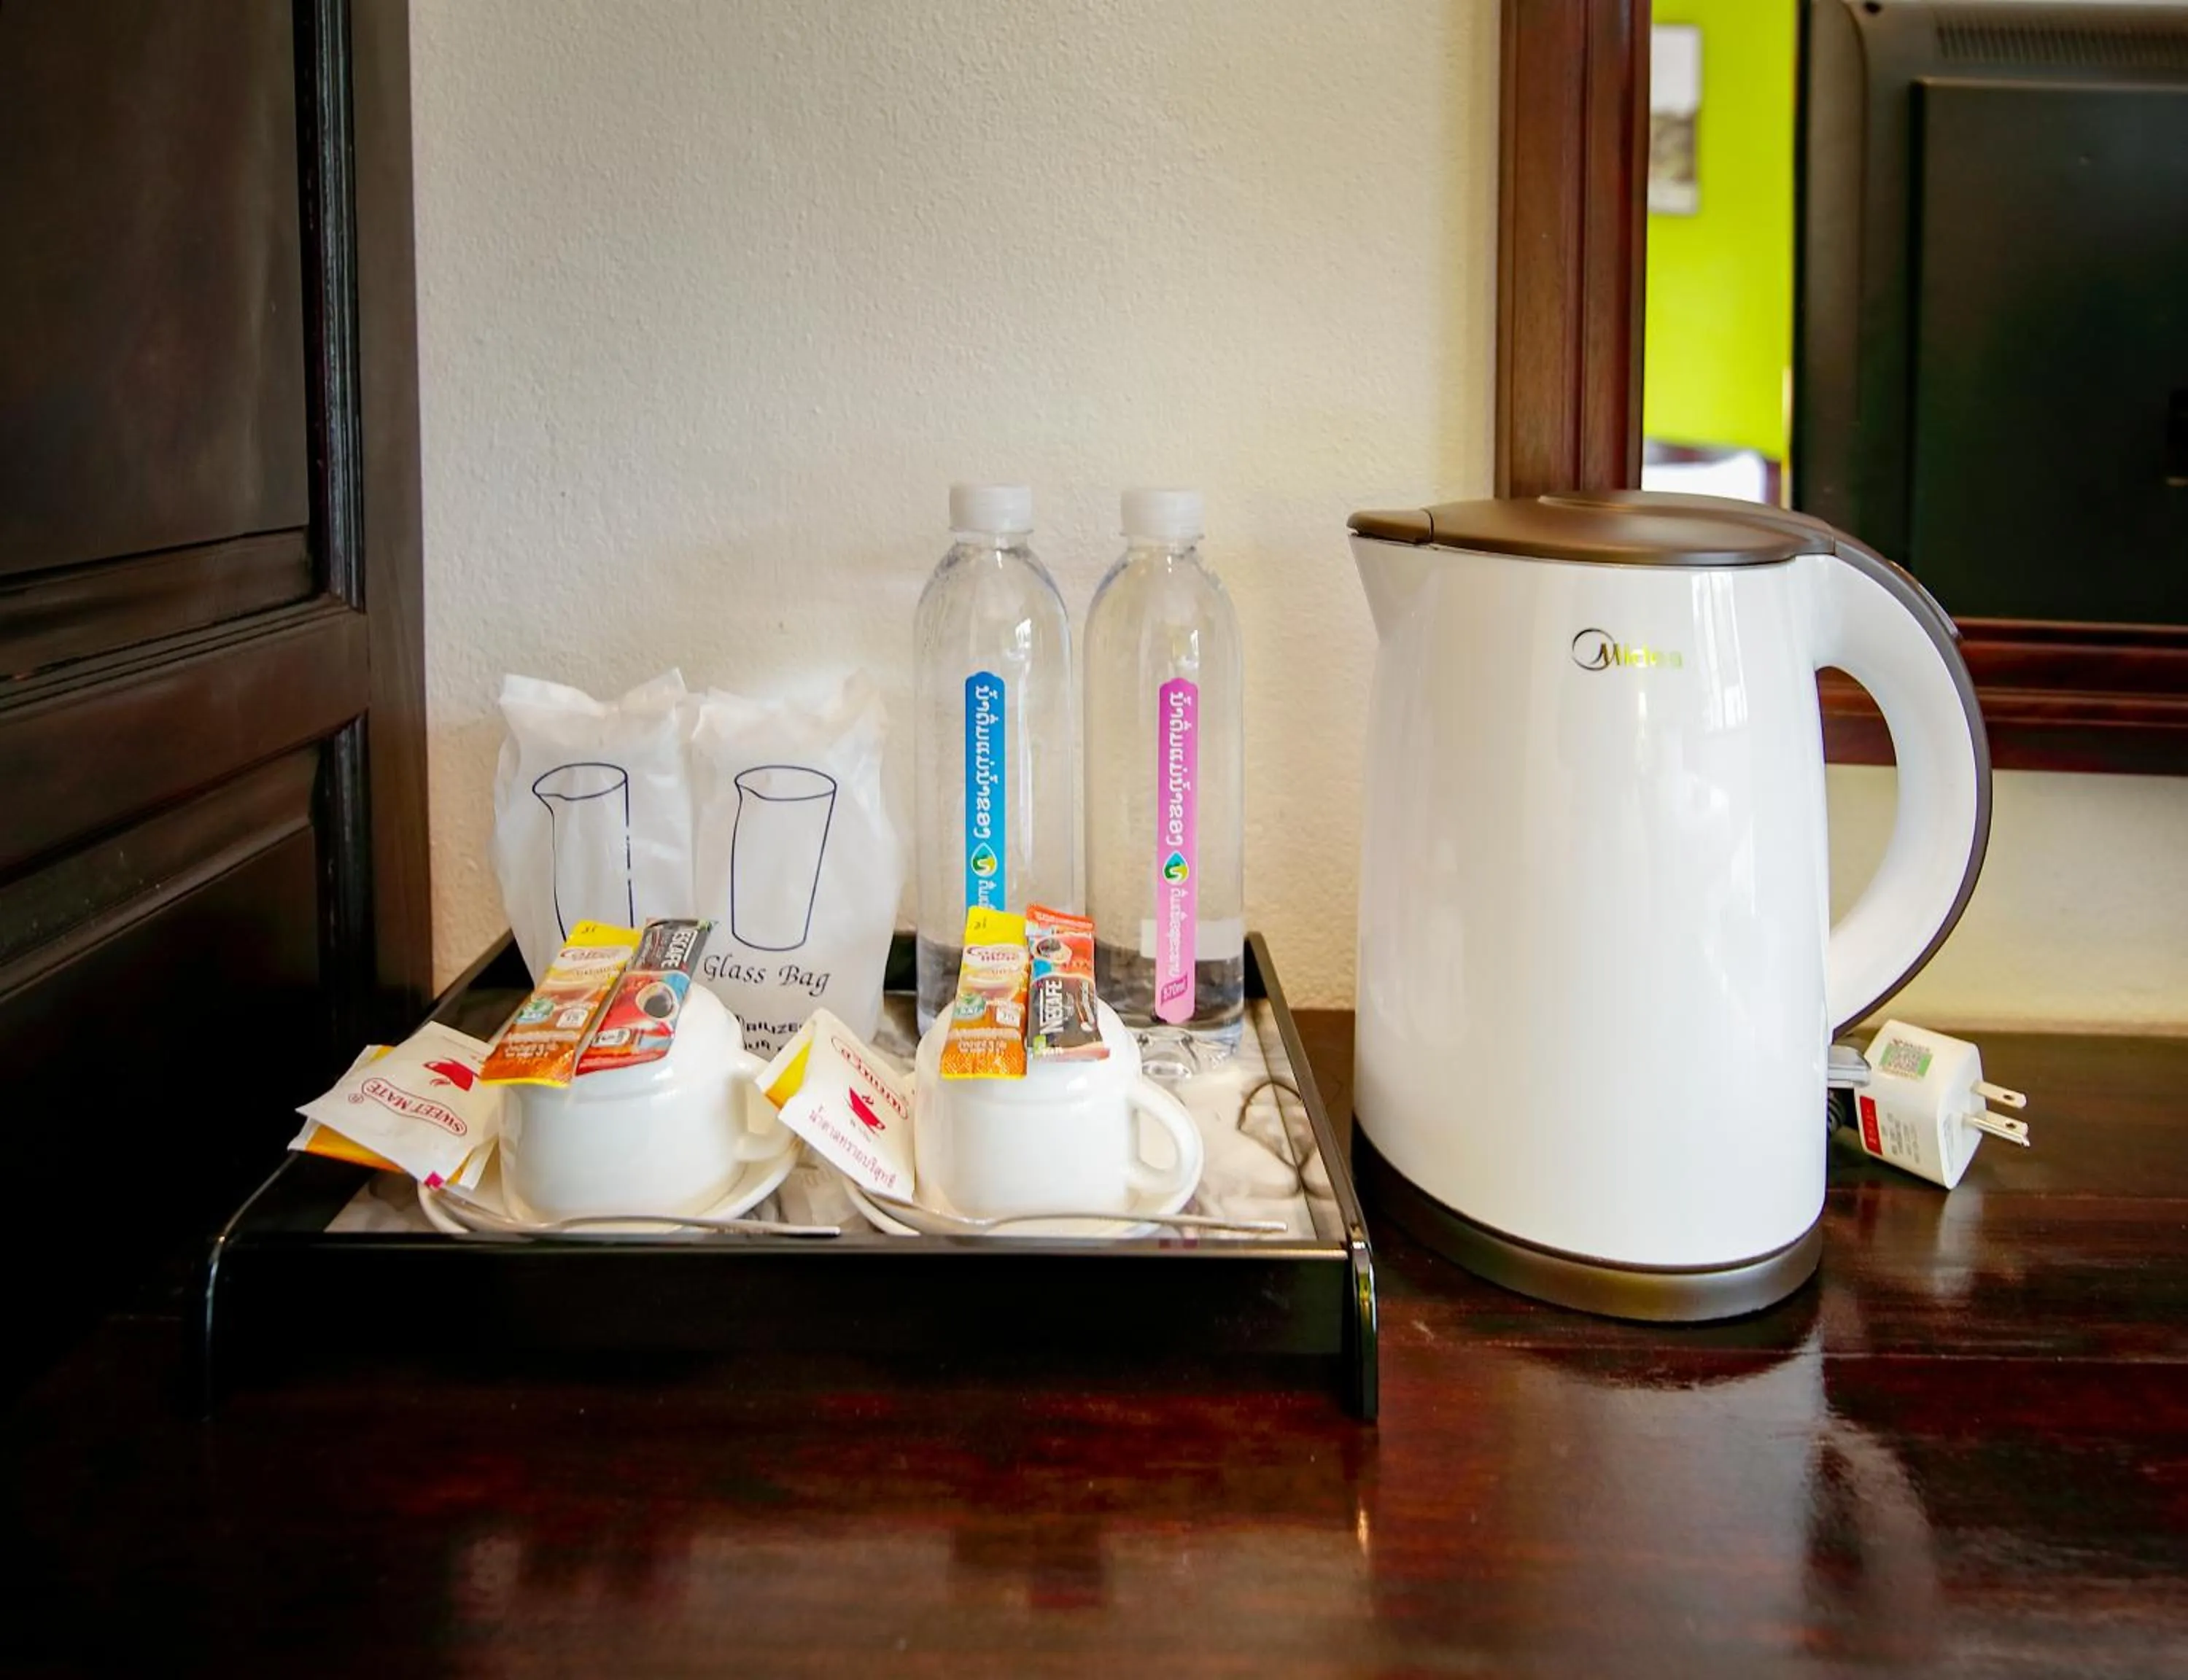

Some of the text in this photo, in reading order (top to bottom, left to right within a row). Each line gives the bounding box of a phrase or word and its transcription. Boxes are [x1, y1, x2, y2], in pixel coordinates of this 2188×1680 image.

[704, 952, 831, 998] Glass Bag
[365, 1081, 465, 1133] SWEET MATE
